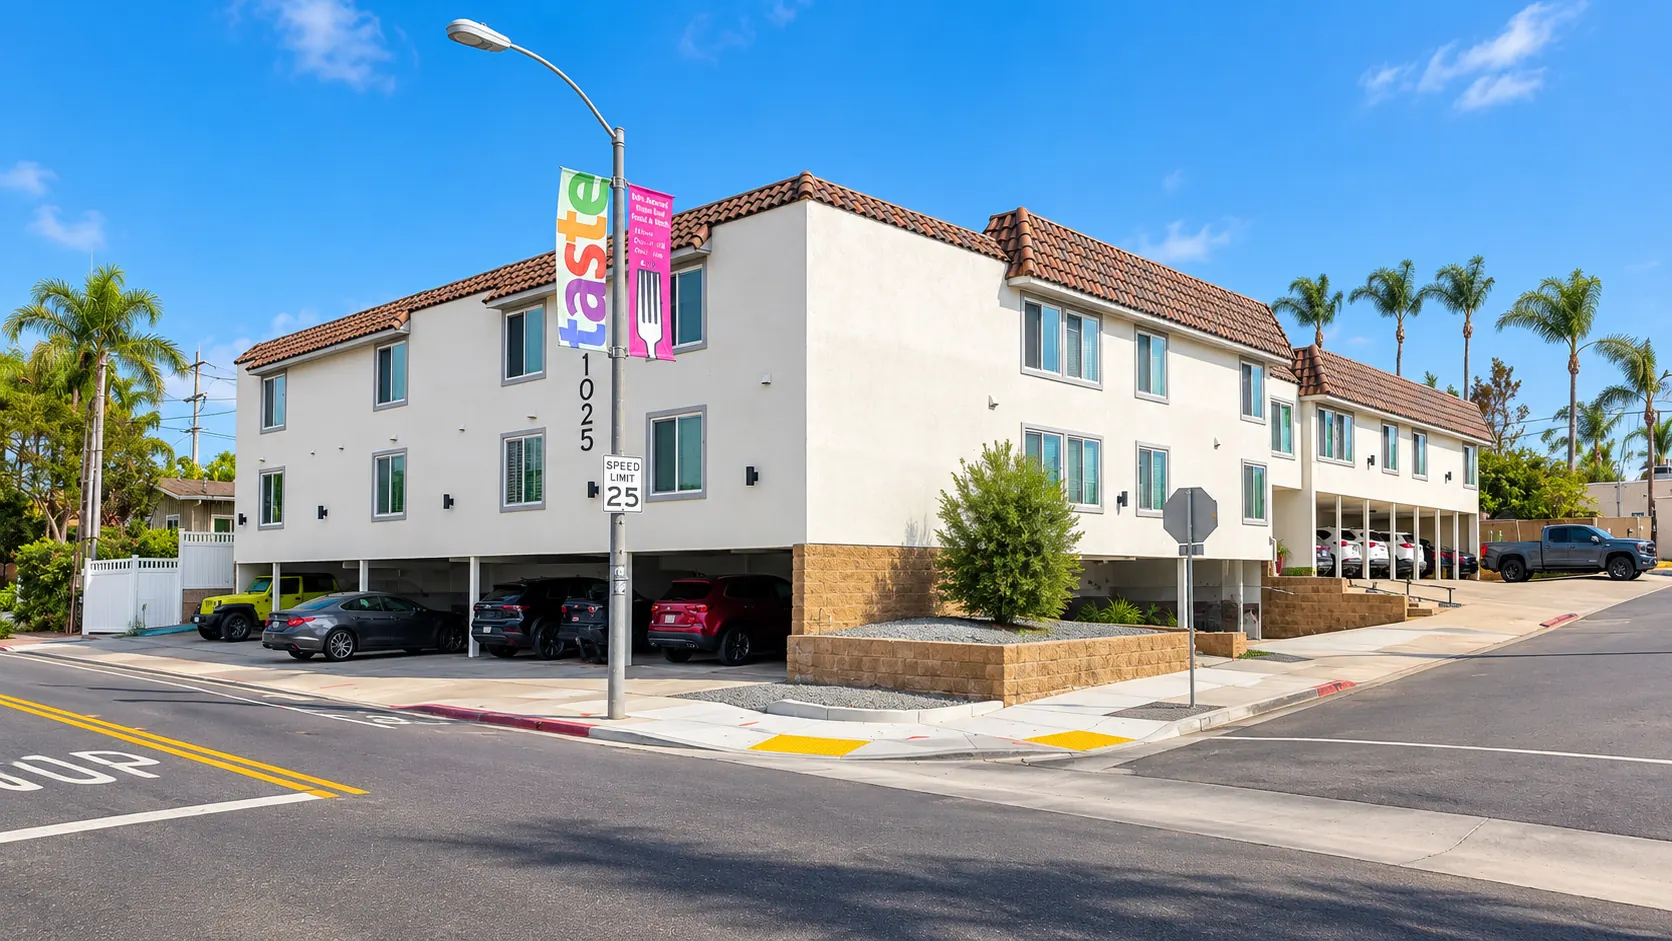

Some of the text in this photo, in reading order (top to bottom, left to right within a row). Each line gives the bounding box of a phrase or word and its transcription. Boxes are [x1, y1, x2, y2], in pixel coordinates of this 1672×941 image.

[558, 172, 609, 348] taste
[579, 352, 595, 452] 1025
[606, 460, 640, 472] SPEED
[610, 473, 635, 483] LIMIT
[606, 486, 639, 508] 25
